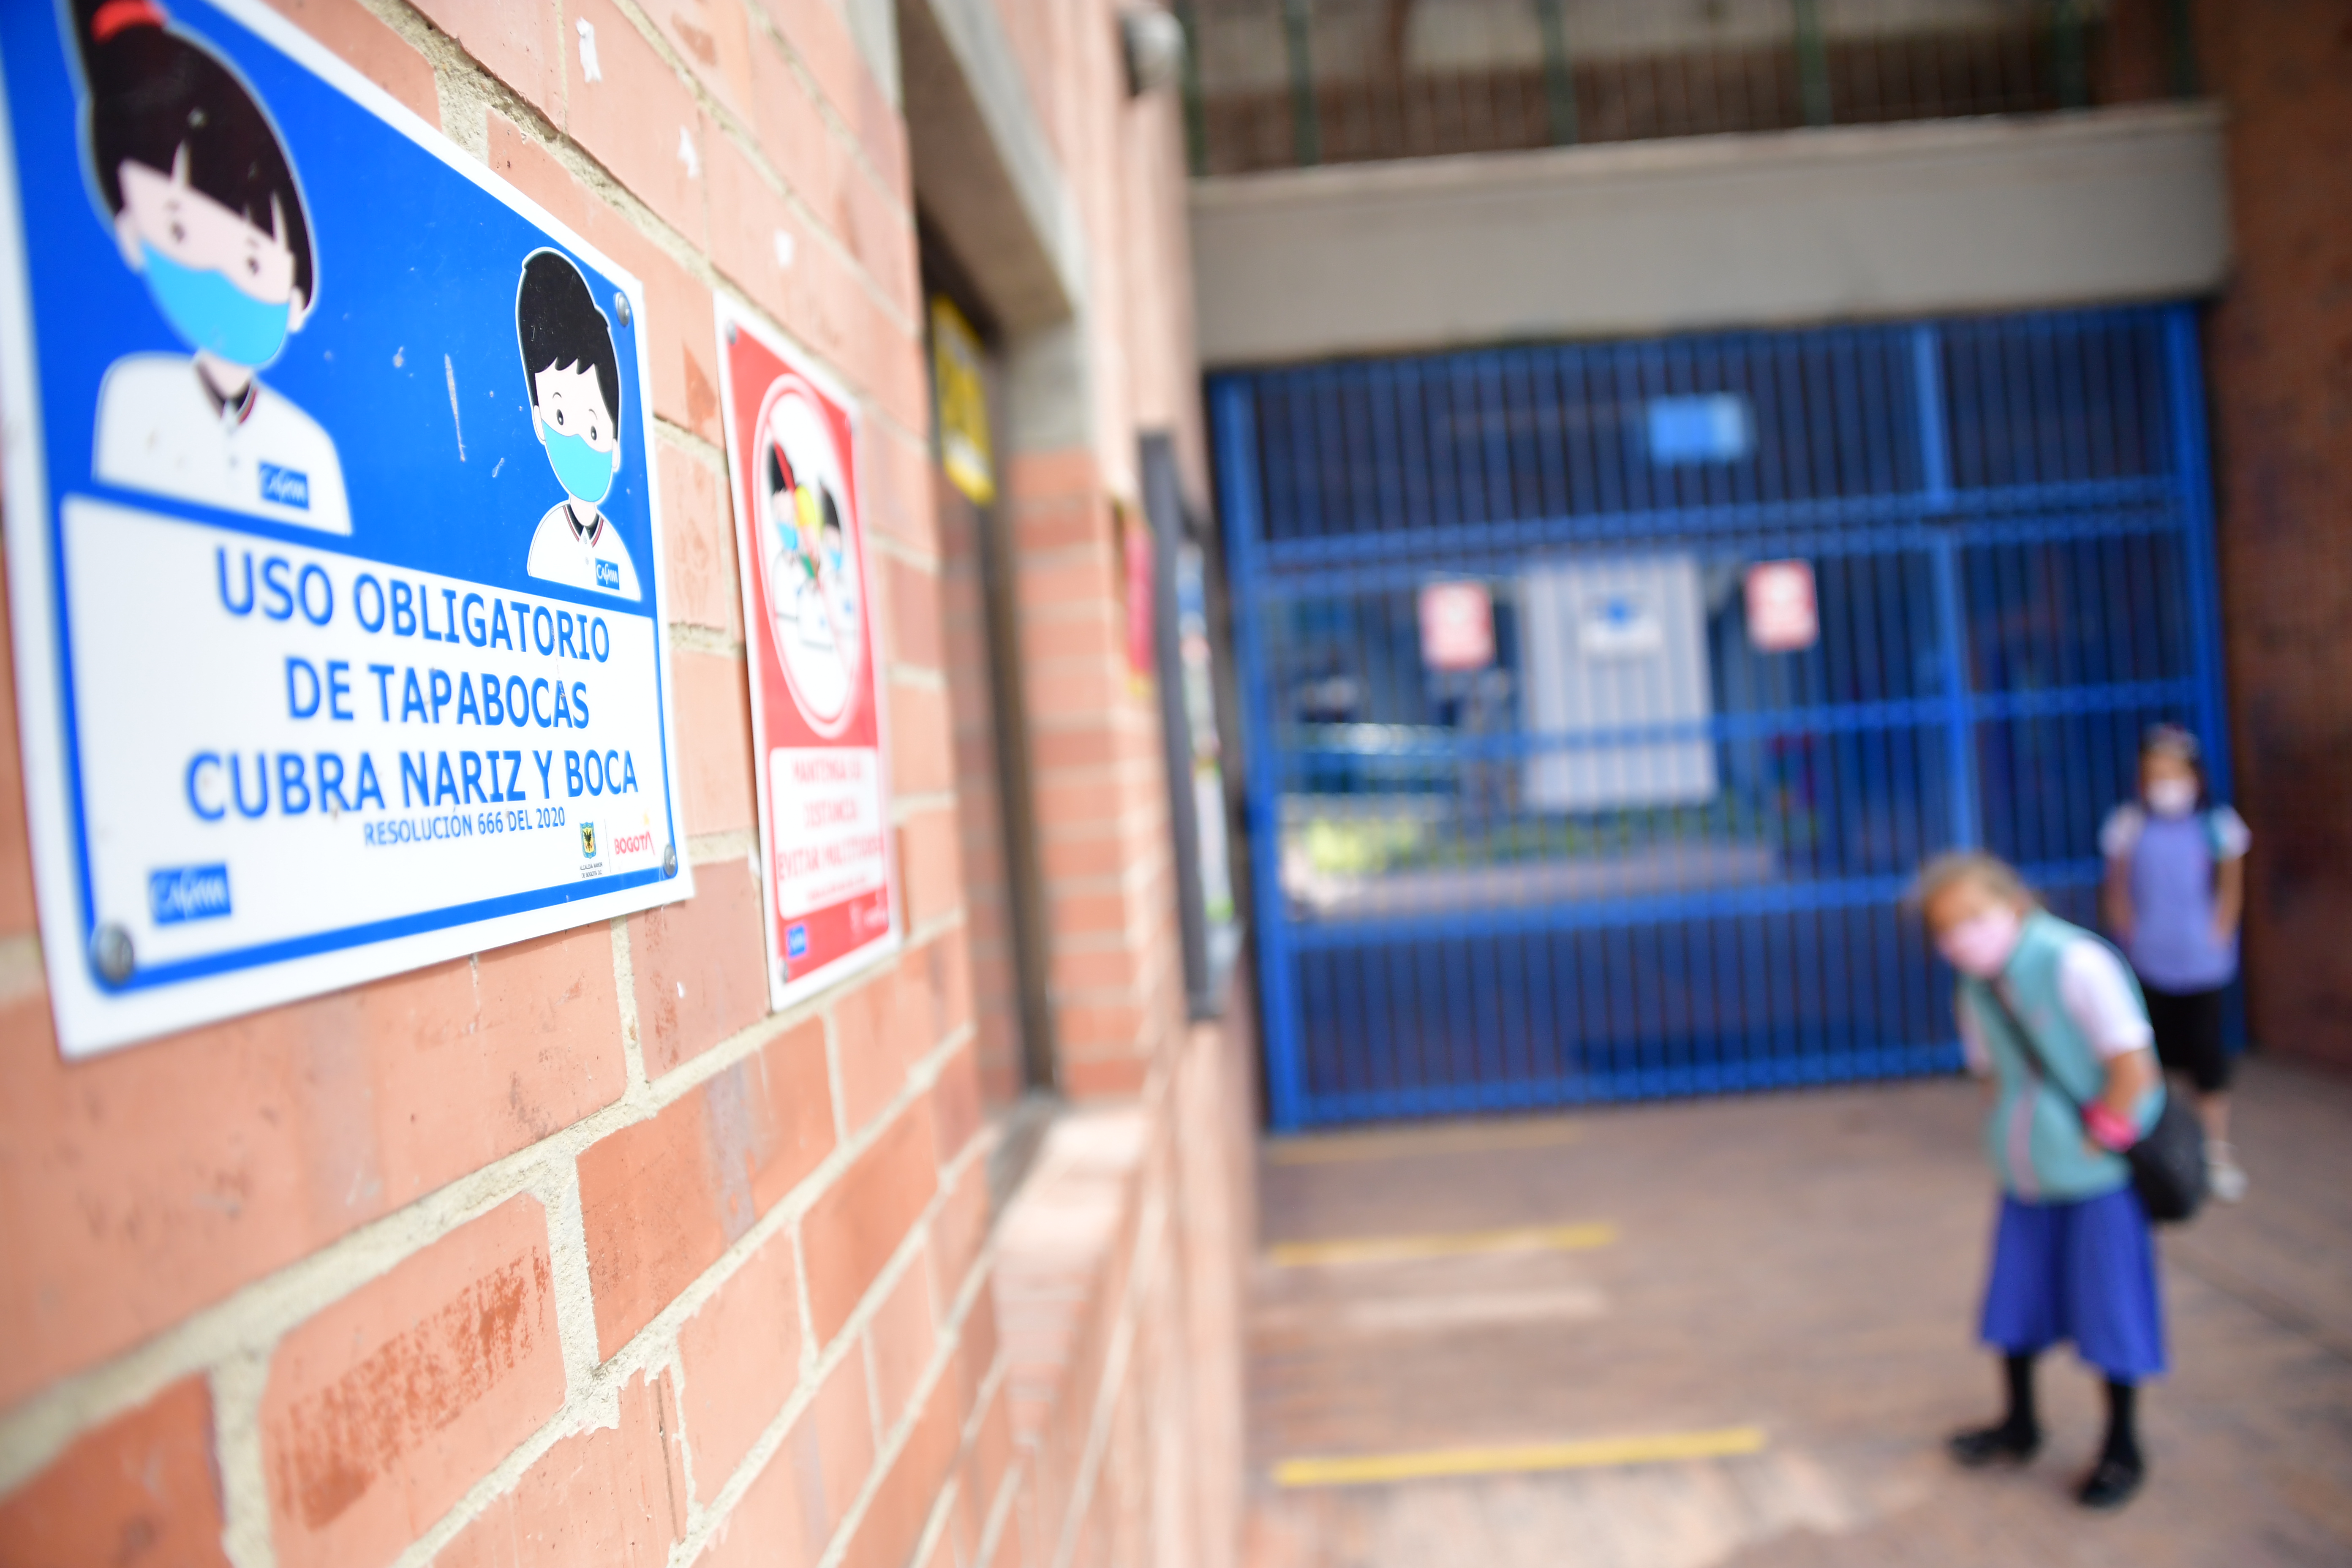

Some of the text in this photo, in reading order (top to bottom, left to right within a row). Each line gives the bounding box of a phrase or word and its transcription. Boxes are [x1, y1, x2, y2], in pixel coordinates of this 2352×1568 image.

[215, 545, 610, 663] USO OBLIGATORIO
[284, 656, 589, 729] DE TAPABOCAS
[183, 749, 639, 824] CUBRA NARIZ Y BOCA
[363, 806, 566, 846] RESOLUCIÓN 666 DEL 2020
